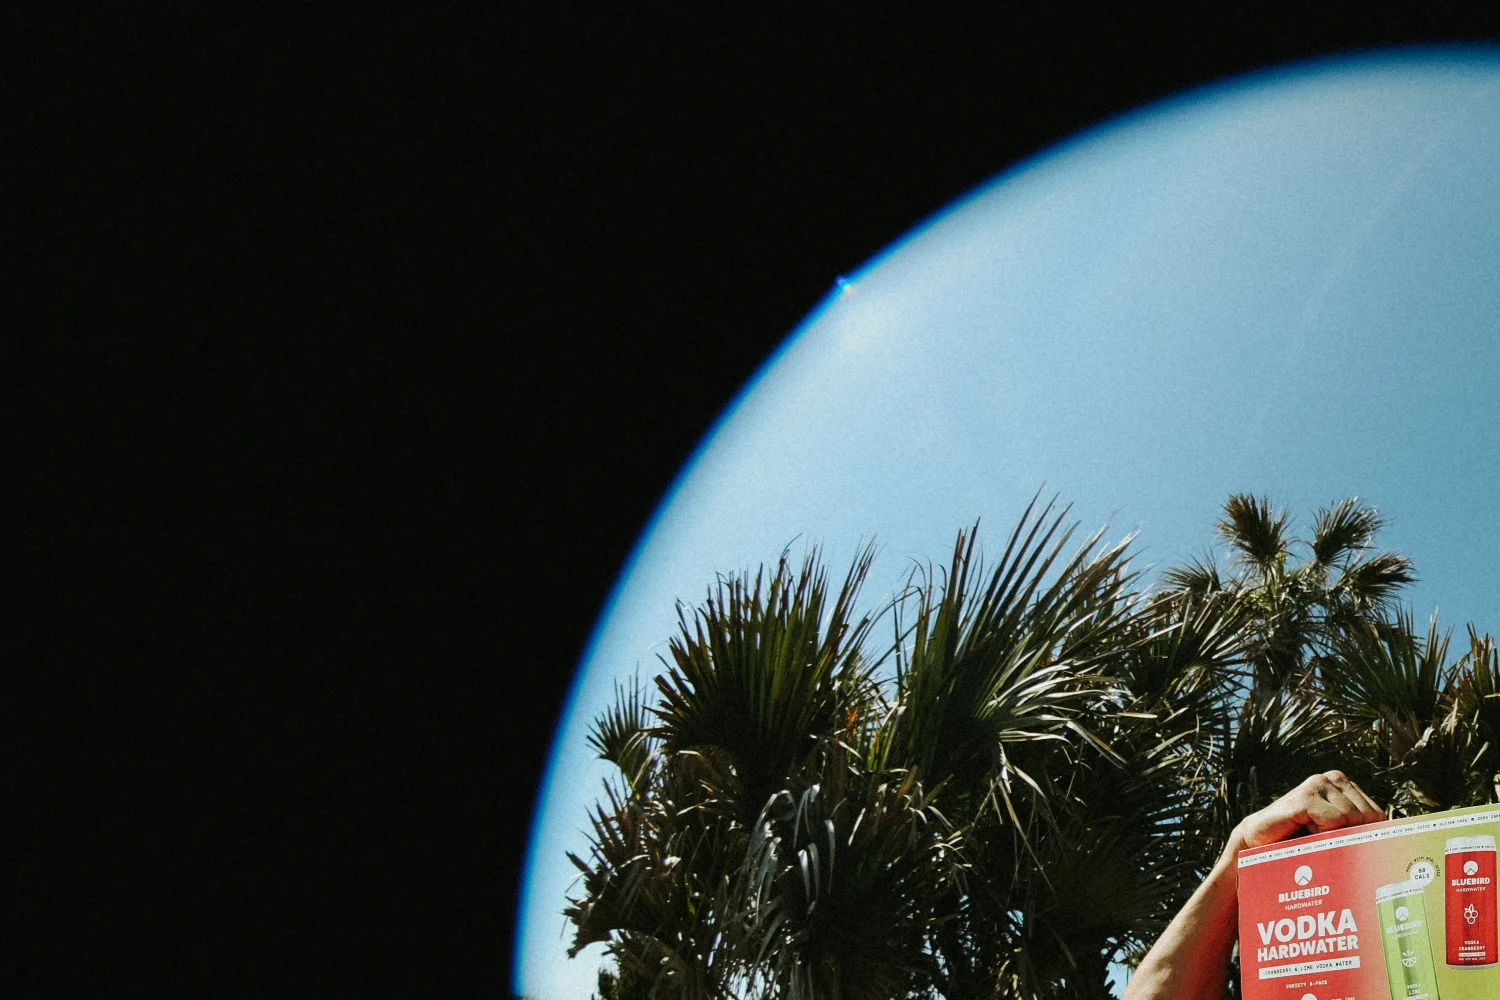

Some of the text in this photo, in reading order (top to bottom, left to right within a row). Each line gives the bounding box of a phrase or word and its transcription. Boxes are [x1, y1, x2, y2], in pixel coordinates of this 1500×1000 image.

[1451, 877, 1491, 886] BLUEBIRD
[1278, 885, 1330, 903] BLUEBIRD
[1285, 899, 1323, 911] HARDWATER
[1257, 908, 1358, 945] VODKA
[1385, 920, 1423, 934] BLUEBIRD
[1257, 934, 1359, 962] HARDWATER
[1264, 968, 1292, 976] CRANBERRY
